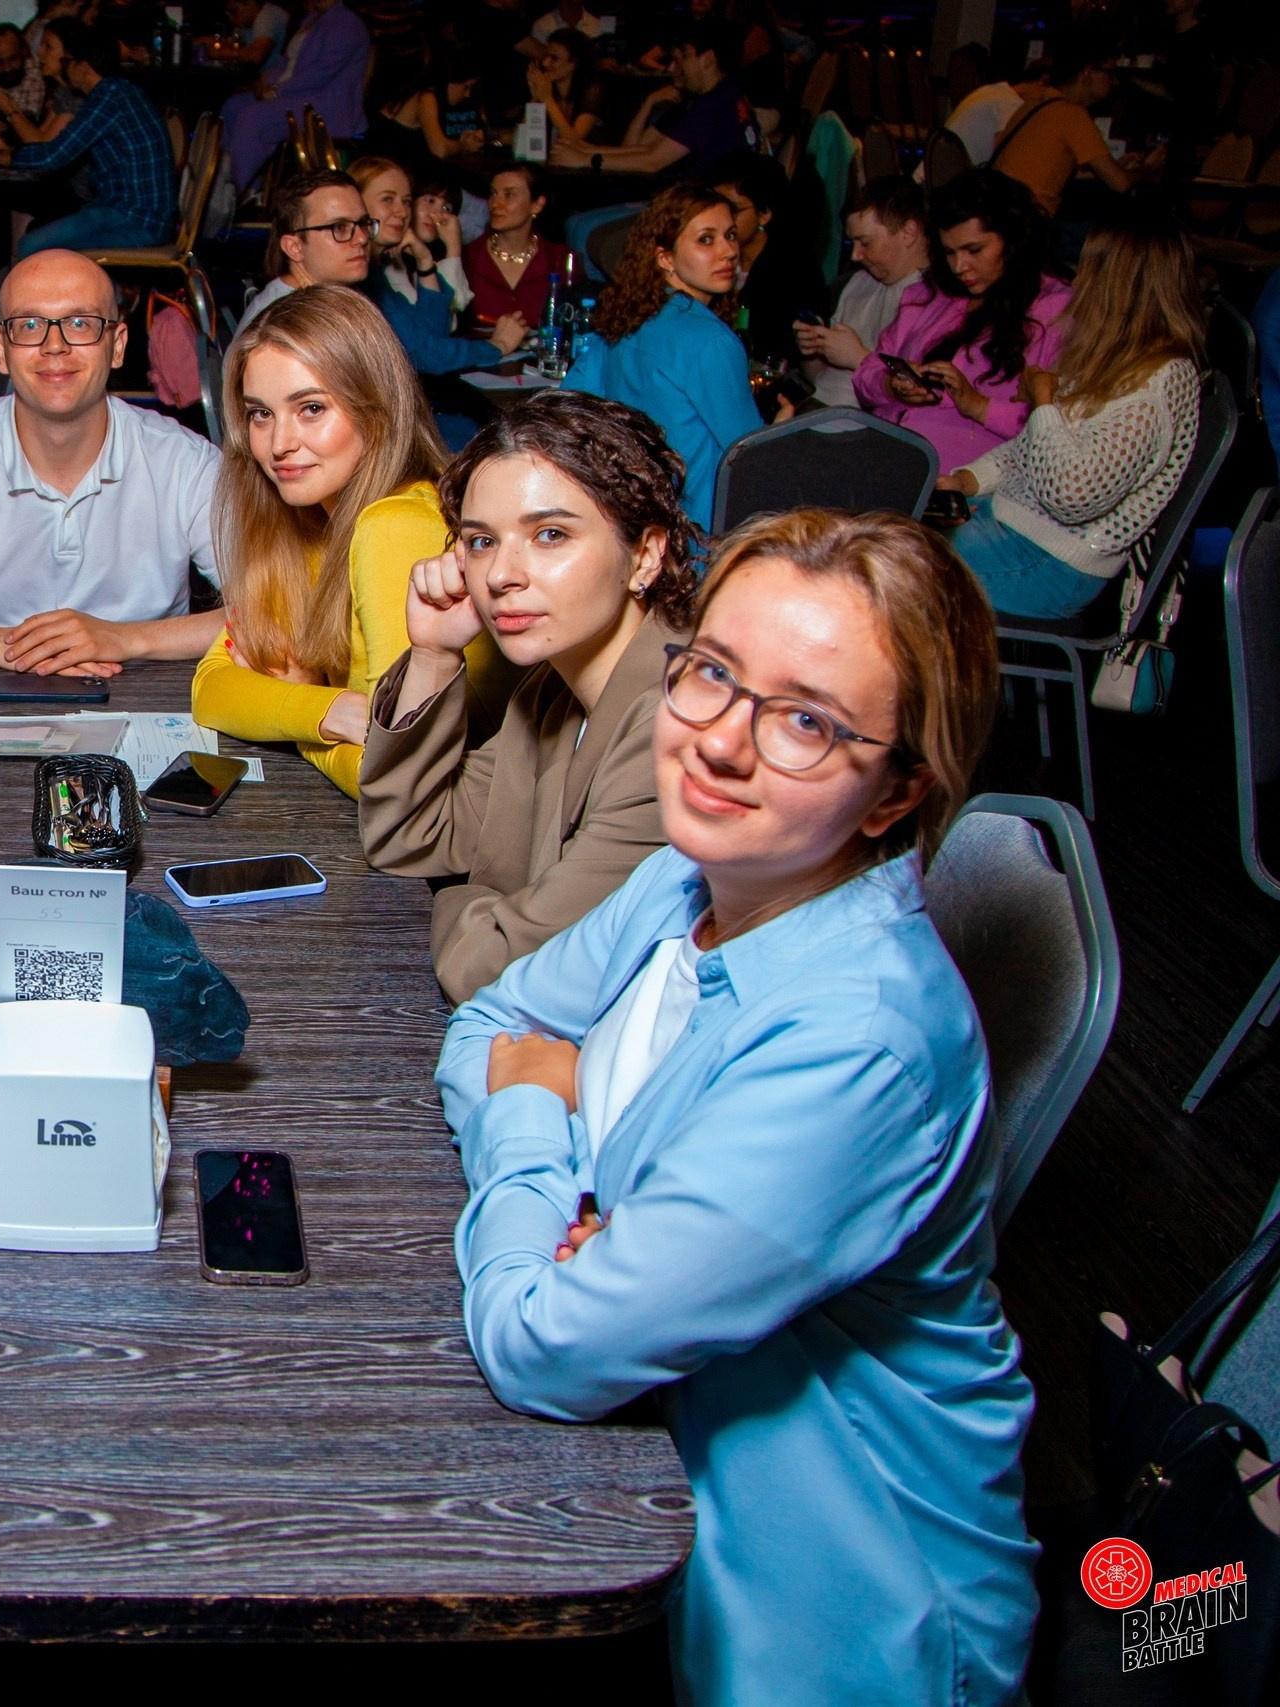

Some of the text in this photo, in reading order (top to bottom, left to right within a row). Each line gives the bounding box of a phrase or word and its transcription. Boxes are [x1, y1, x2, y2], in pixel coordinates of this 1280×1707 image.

[10, 885, 44, 897] Ваш
[48, 888, 85, 898] стол
[37, 1118, 97, 1147] Lime
